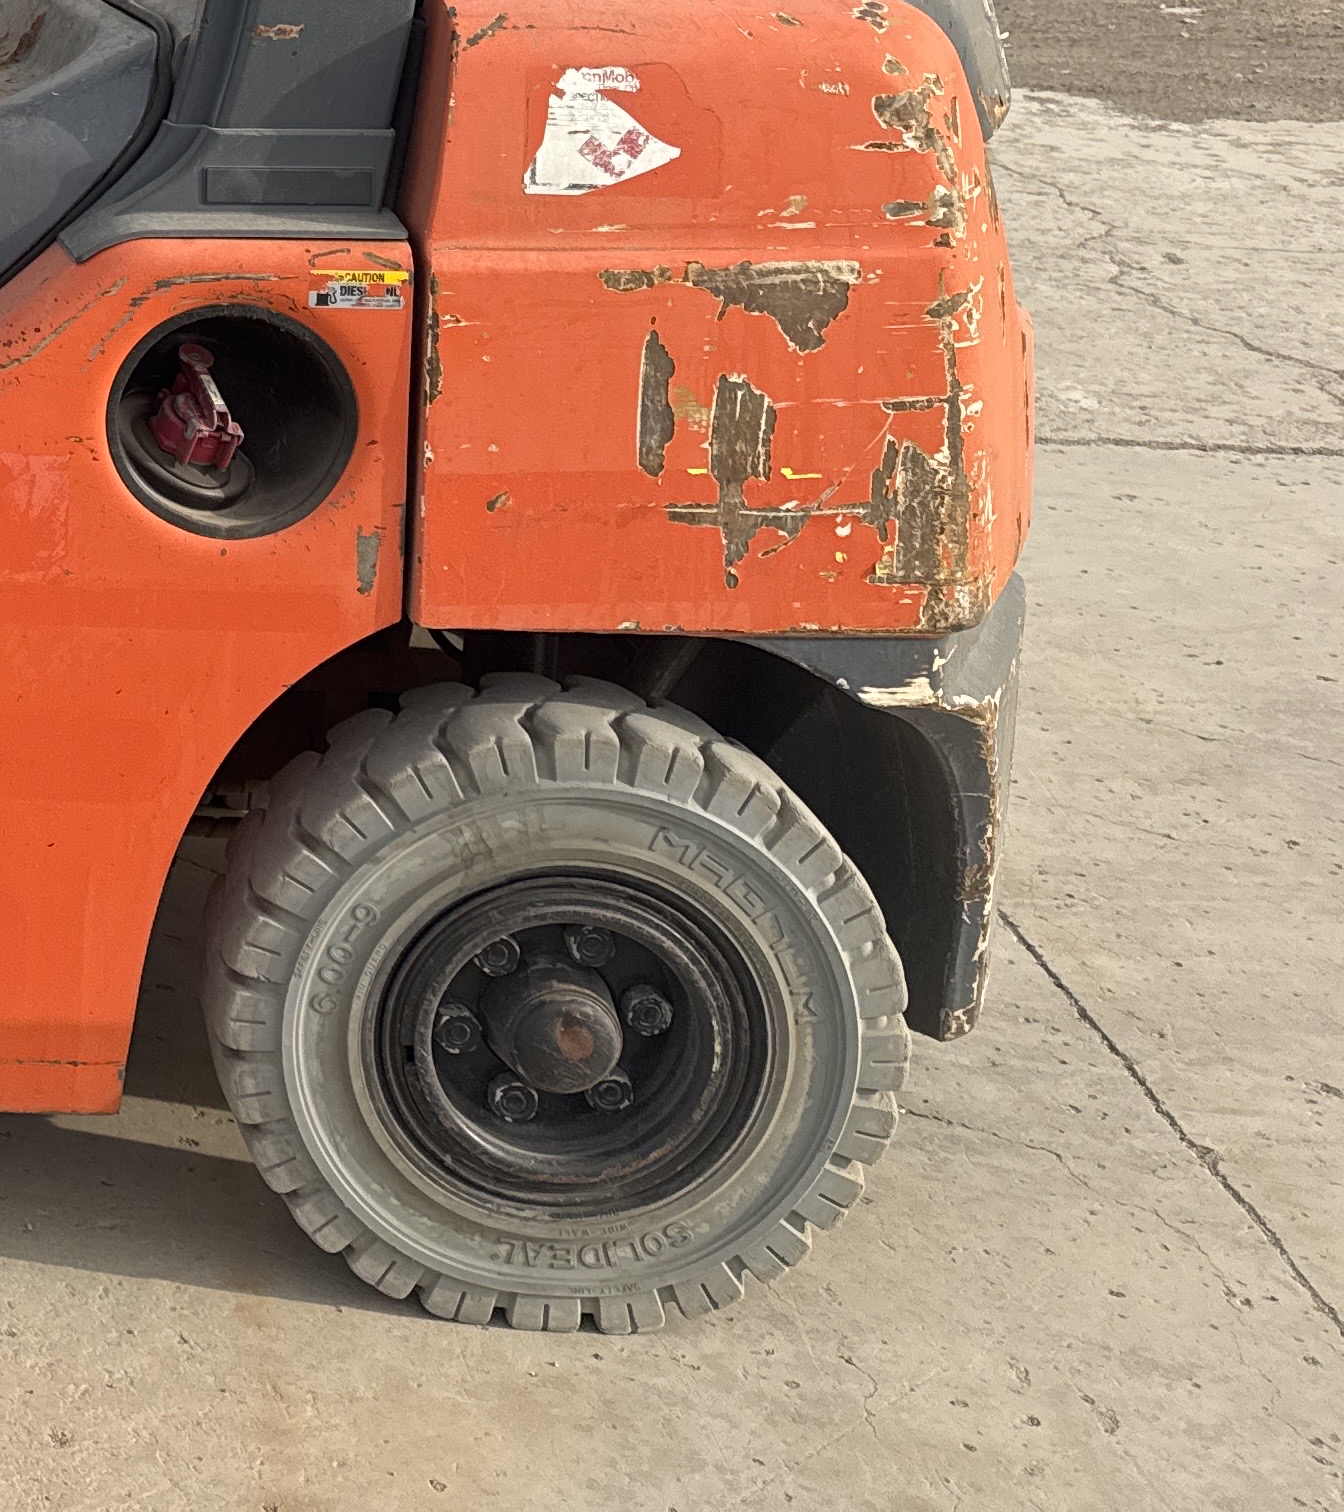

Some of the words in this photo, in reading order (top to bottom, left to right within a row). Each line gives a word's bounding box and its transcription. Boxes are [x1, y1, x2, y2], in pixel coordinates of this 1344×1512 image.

[345, 273, 385, 283] CAUTION
[309, 901, 381, 1015] 6.00-9
[493, 1222, 694, 1270] SOLIDEAL
